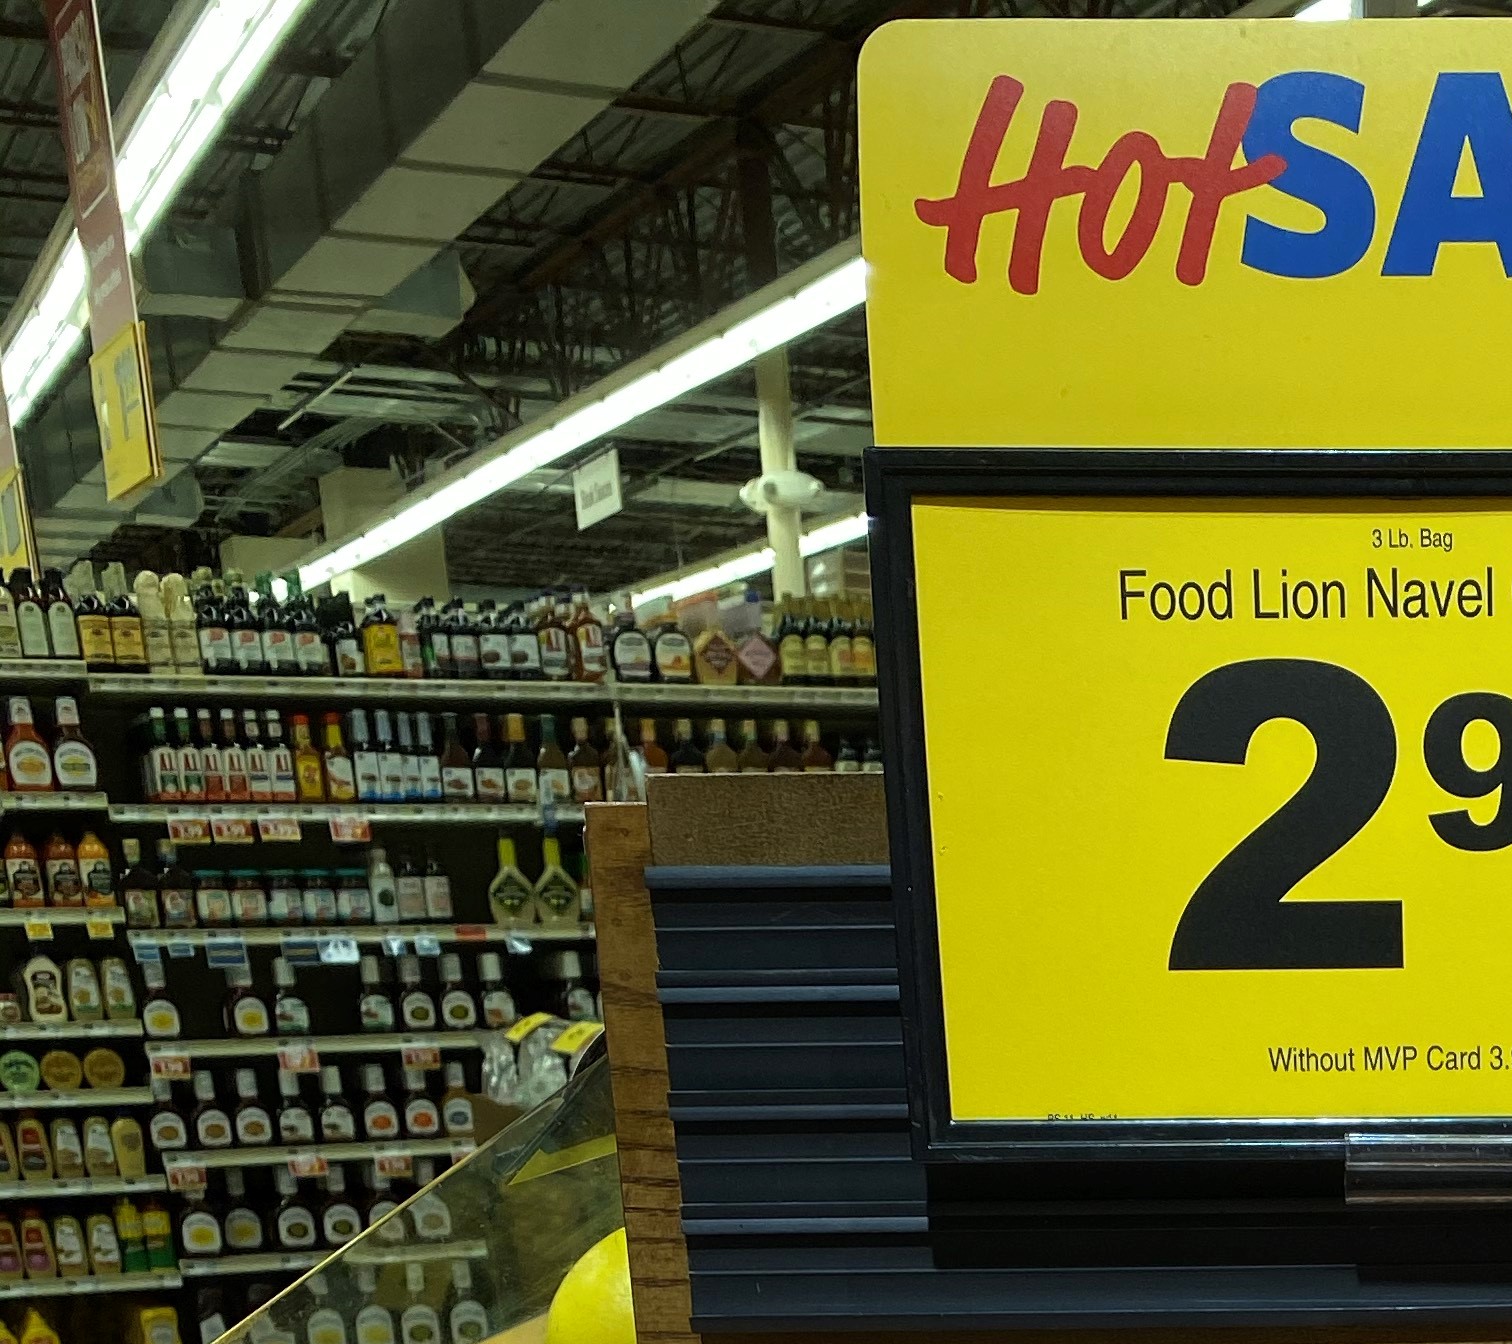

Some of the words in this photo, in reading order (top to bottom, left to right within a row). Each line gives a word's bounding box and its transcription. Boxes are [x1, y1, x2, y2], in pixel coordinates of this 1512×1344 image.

[1371, 529, 1382, 549] 3
[1386, 529, 1413, 549] Lb.
[1420, 529, 1454, 552] Bag
[1119, 567, 1234, 621] Food
[1253, 567, 1346, 621] Lion
[1366, 567, 1495, 621] Navel
[1268, 1046, 1355, 1071] Without
[1362, 1046, 1418, 1071] MVP
[1425, 1046, 1482, 1071] Card
